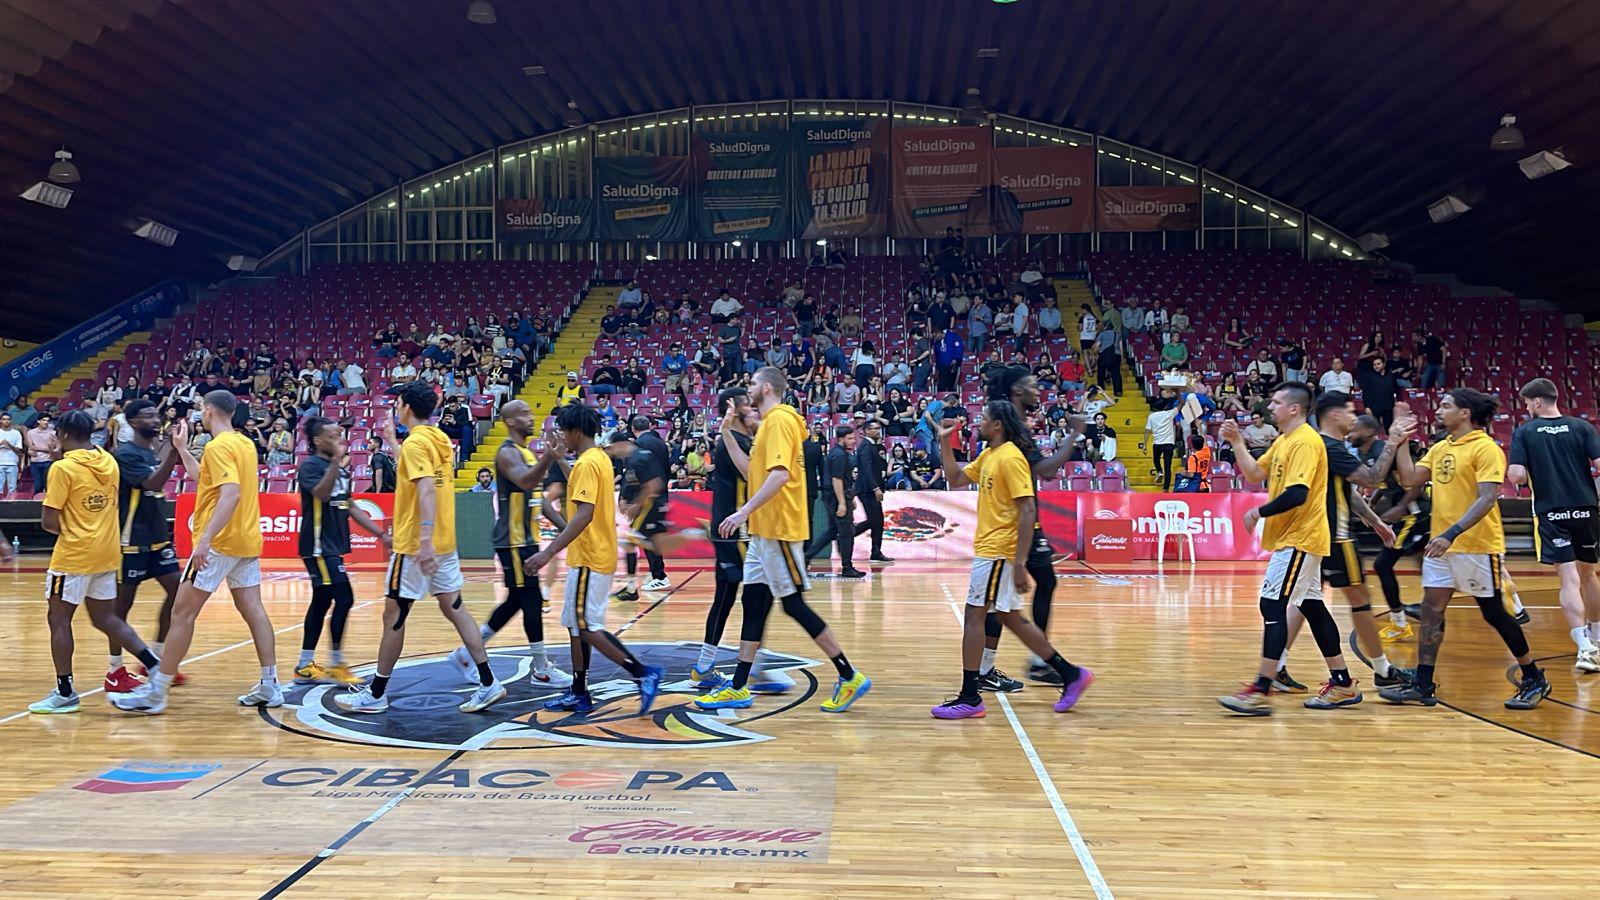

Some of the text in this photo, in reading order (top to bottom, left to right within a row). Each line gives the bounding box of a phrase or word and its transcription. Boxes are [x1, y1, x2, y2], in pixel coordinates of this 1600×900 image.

[806, 128, 872, 142] SaludDigna
[709, 141, 771, 155] SaludDigna
[904, 138, 976, 154] SaludDigna
[1000, 174, 1081, 190] SaludDigna
[602, 183, 679, 200] SaludDigna
[831, 199, 867, 219] SALUD
[1104, 200, 1187, 215] SaludDigna
[506, 212, 582, 229] SaludDigna
[11, 350, 53, 379] ETREME
[1547, 510, 1591, 521] Soni Gas
[1091, 533, 1128, 546] Caliente
[312, 789, 362, 798] Liga
[370, 790, 476, 799] Mexicana
[482, 791, 510, 800] de
[568, 819, 823, 844] Caliente
[623, 844, 811, 858] caliente.mx
